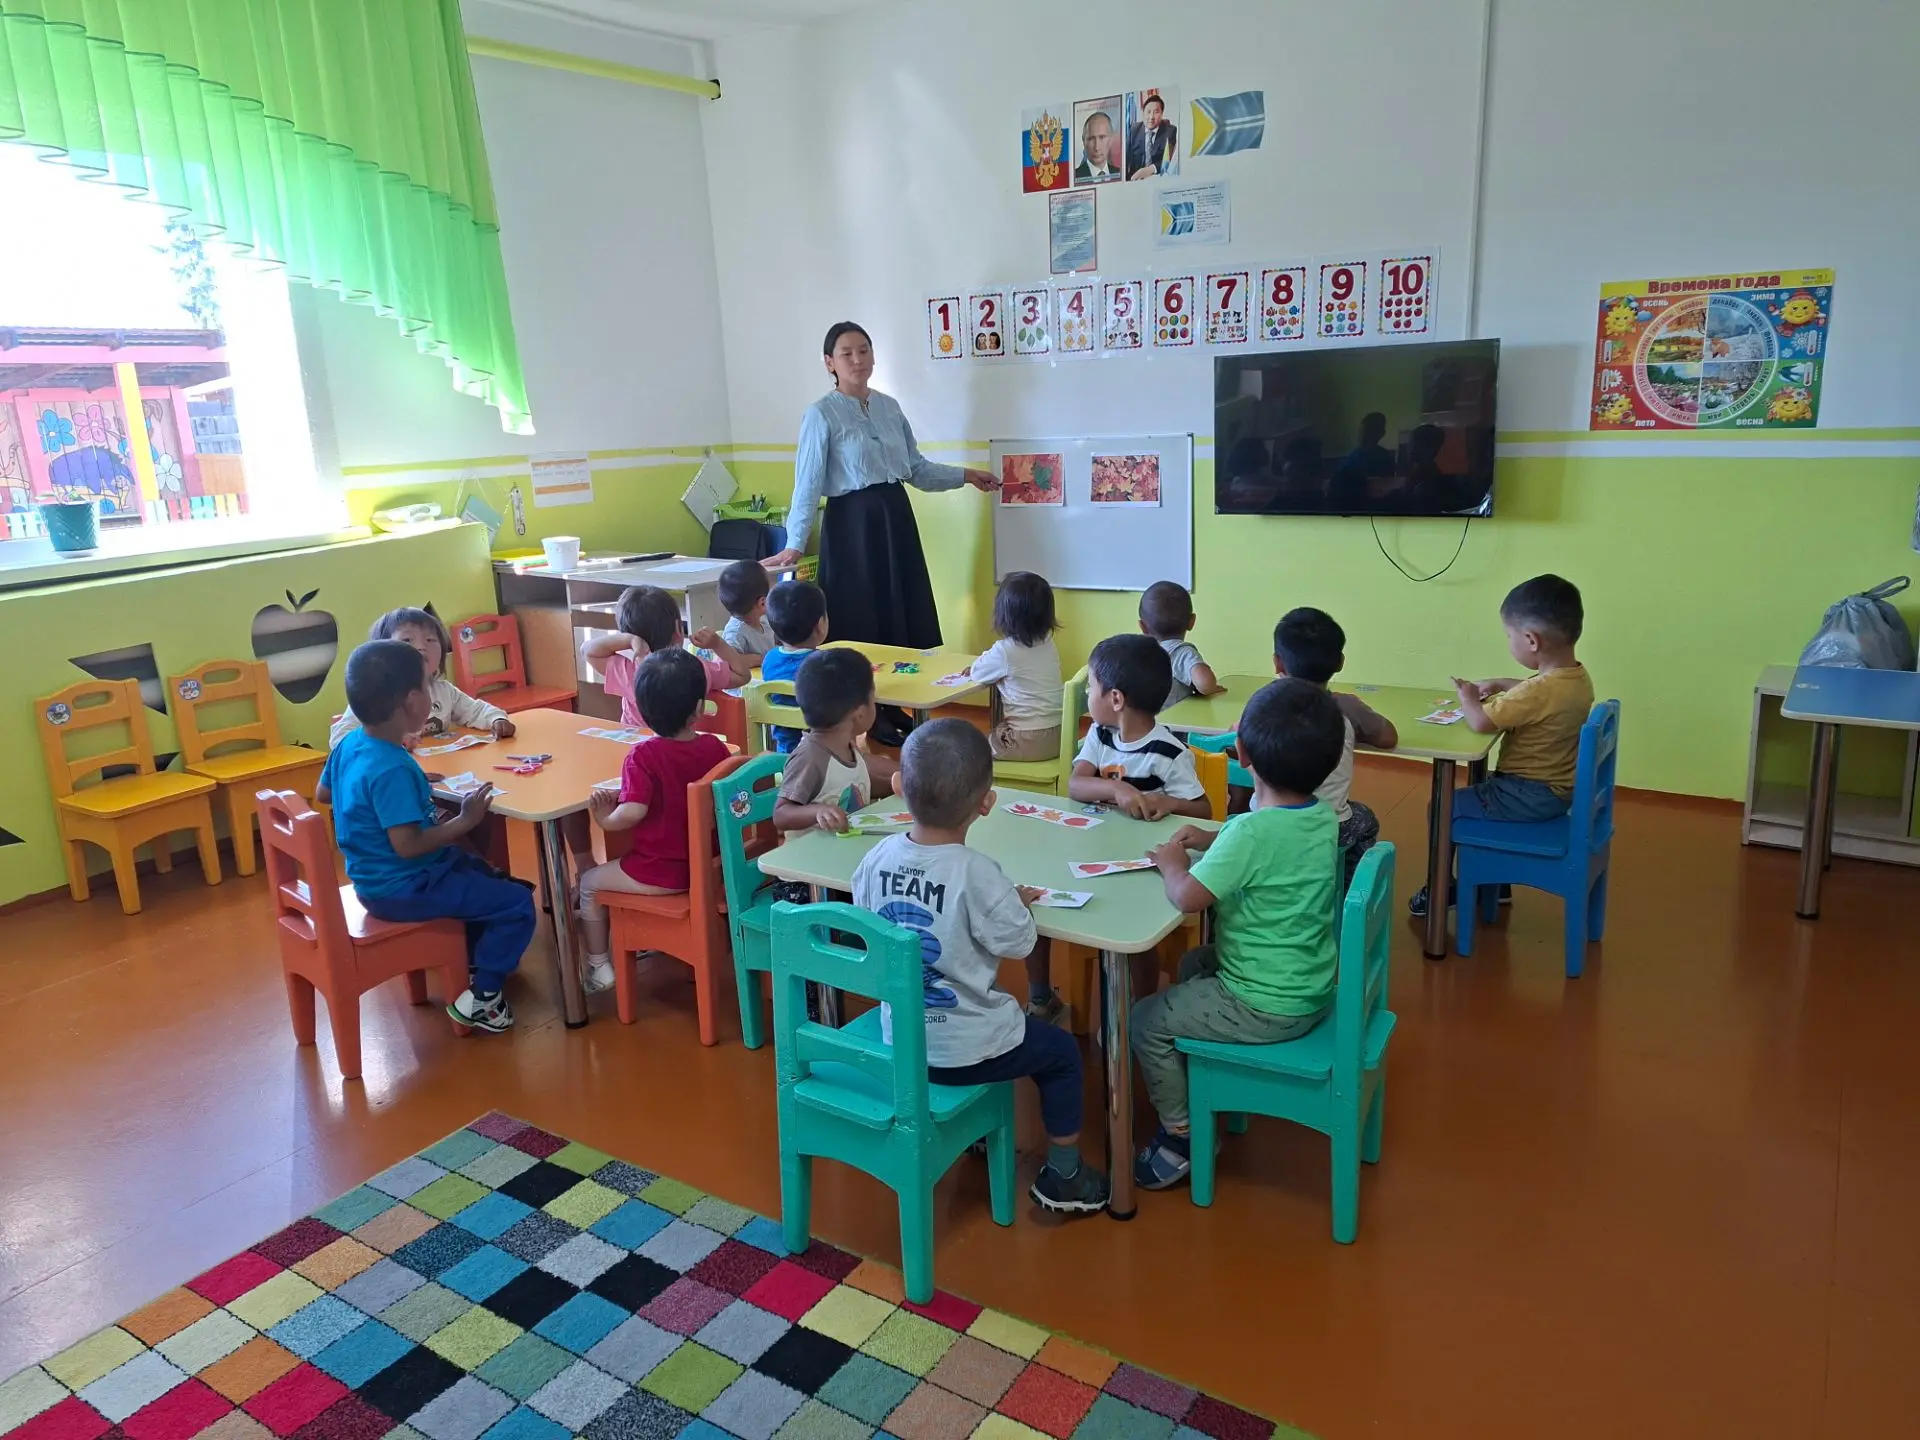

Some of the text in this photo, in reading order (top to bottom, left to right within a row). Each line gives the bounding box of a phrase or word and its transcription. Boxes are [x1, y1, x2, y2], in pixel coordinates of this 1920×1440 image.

[1735, 275, 1781, 289] года
[938, 263, 1424, 331] 1 2 3 4 5 6 7 8 9 10
[898, 865, 926, 878] PLAYOFF
[879, 870, 946, 915] TEAM
[924, 1015, 947, 1024] CORED
